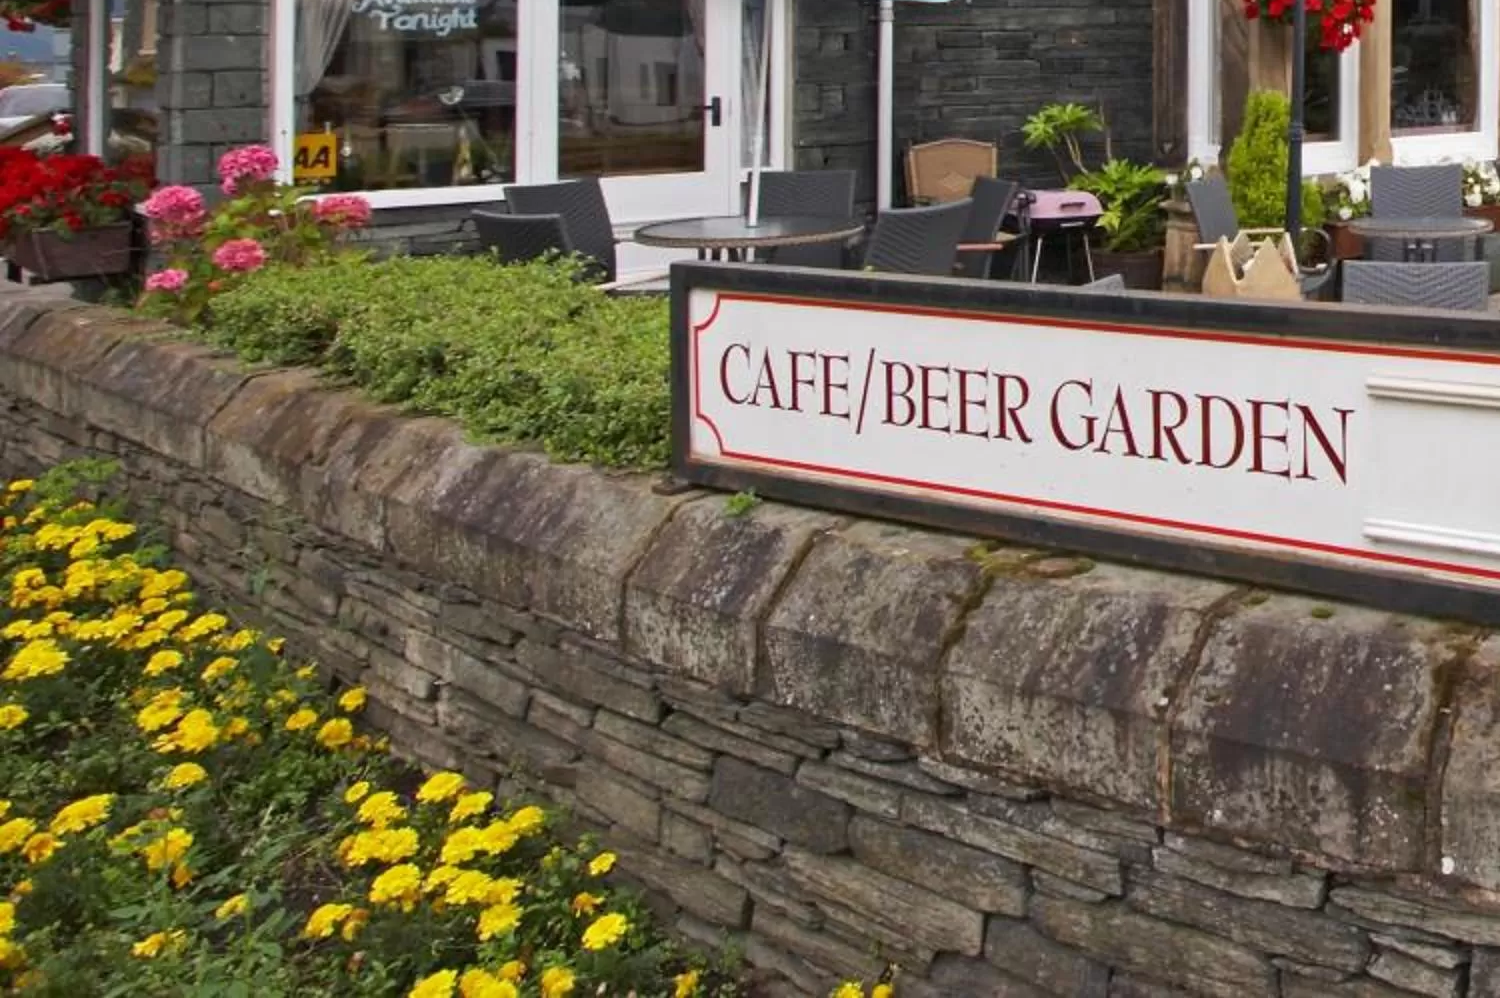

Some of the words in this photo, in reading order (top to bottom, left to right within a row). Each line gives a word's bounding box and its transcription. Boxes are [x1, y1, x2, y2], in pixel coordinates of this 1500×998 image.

[369, 4, 478, 36] Tonight
[294, 145, 330, 170] AA
[719, 342, 1034, 445] CAFE/BEER
[1049, 378, 1355, 485] GARDEN
